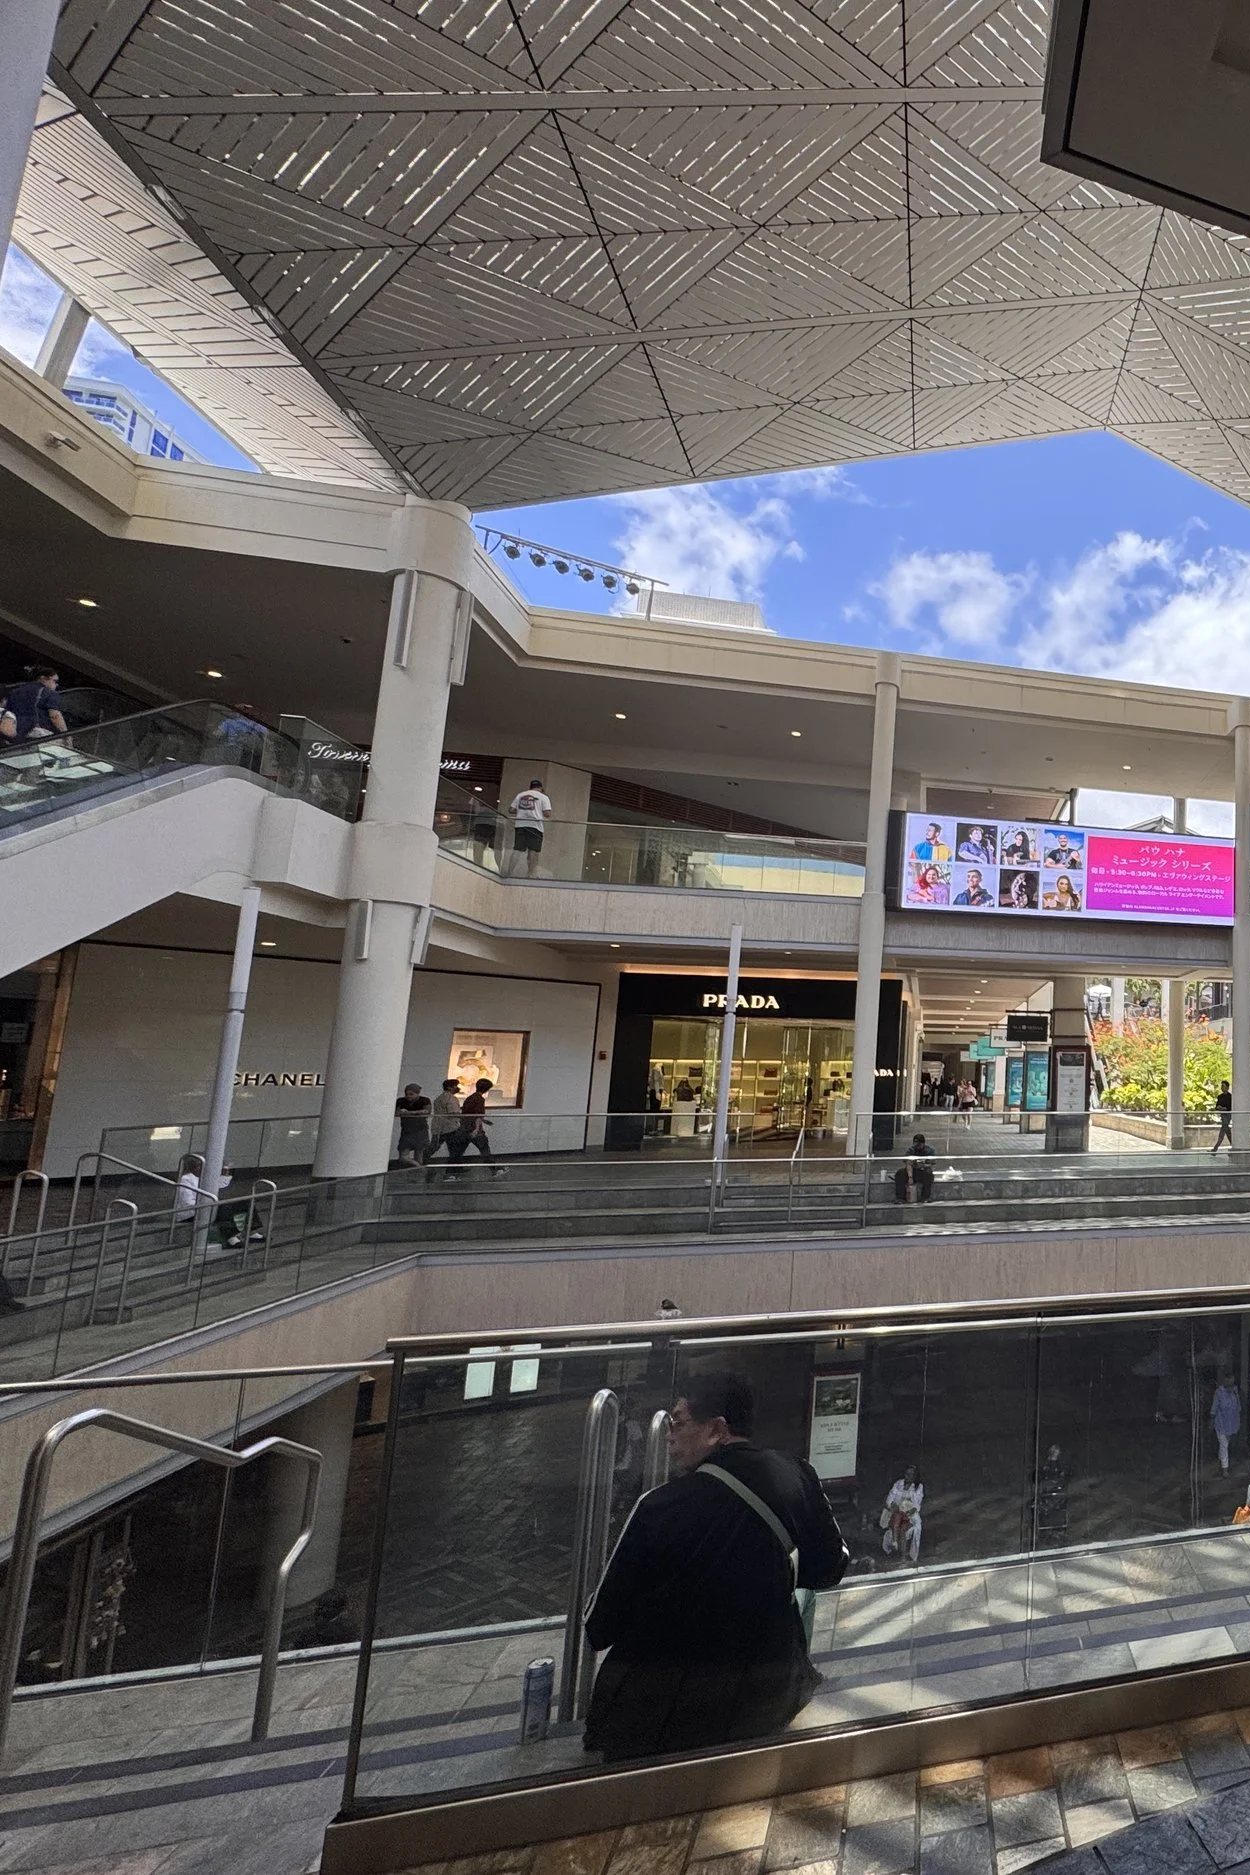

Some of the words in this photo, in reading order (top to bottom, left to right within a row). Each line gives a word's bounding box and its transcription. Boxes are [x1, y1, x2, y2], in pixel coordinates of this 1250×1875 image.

[1112, 855, 1168, 868] ミュージック
[1171, 860, 1213, 872] シリーズ
[234, 1072, 326, 1087] CHANEL
[873, 1068, 894, 1077] ADA
